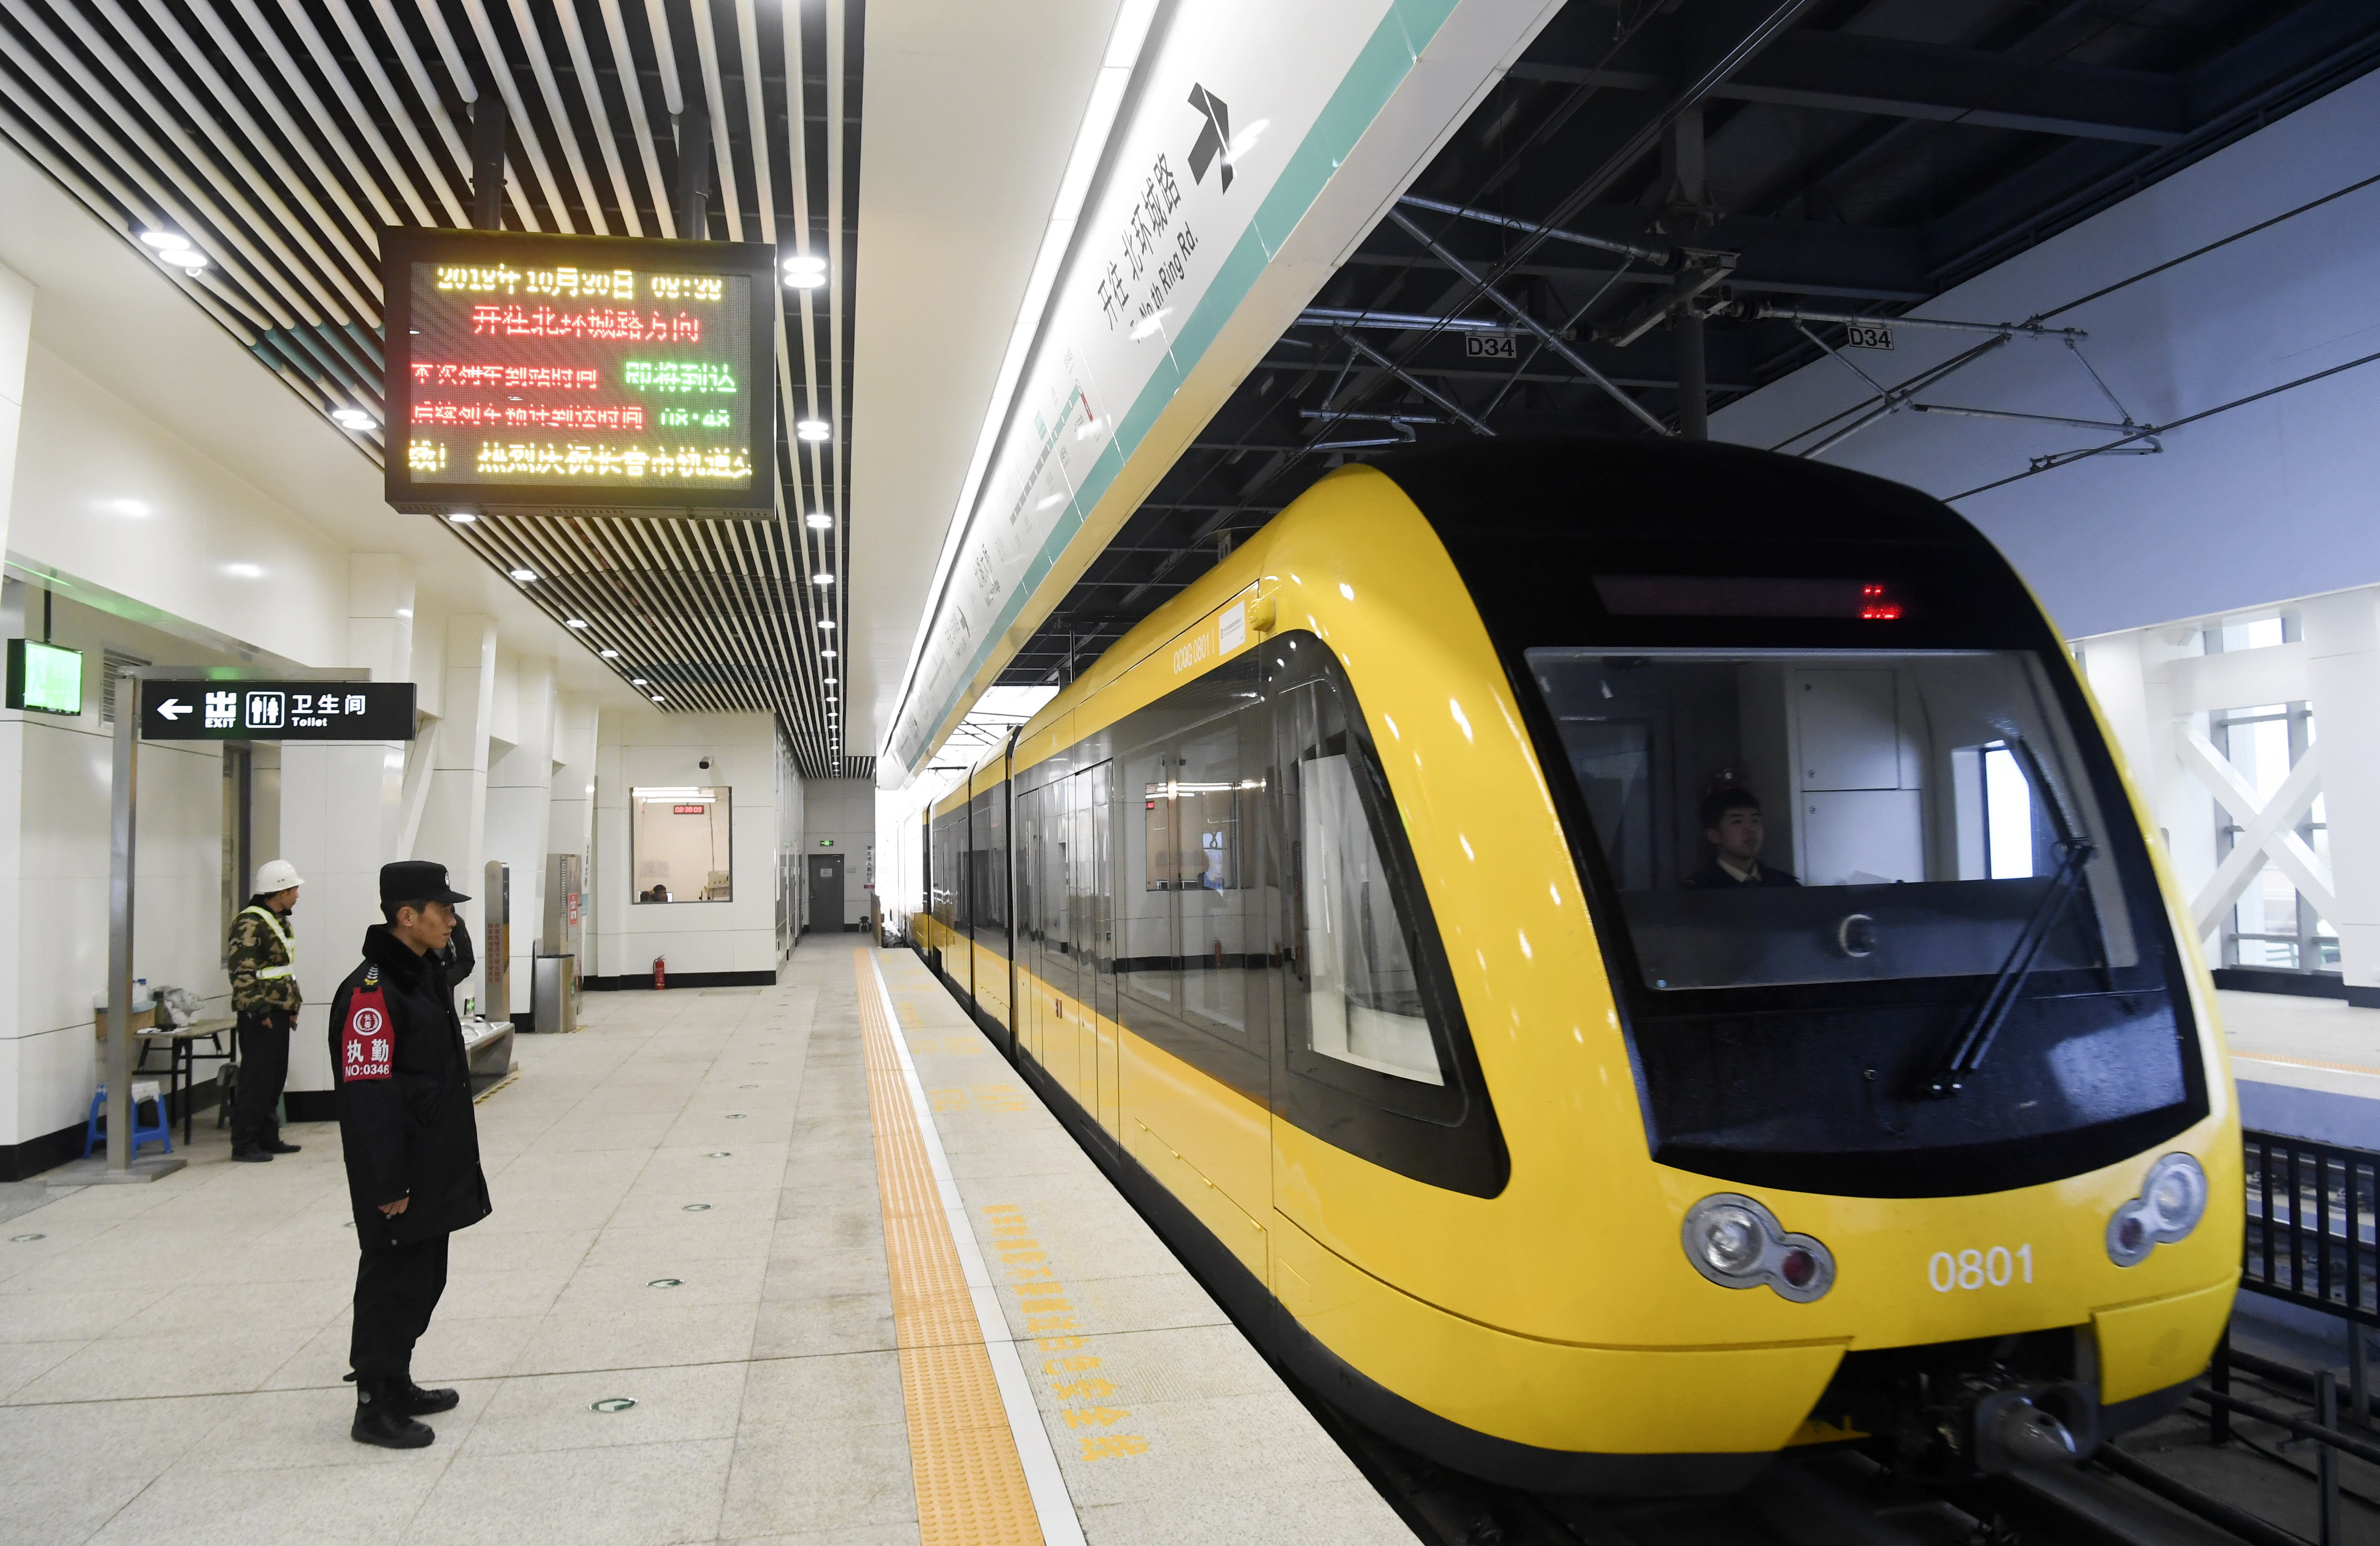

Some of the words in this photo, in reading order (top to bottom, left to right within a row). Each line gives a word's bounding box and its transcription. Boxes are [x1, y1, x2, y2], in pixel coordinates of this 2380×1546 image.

[1097, 260, 1129, 331] 开往
[1122, 152, 1181, 281] 北环城路
[1139, 282, 1164, 320] Noth
[1158, 252, 1185, 295] Ring
[1177, 220, 1198, 262] Rd.
[473, 304, 699, 342] 开往北环城路方向
[1468, 337, 1514, 357] D34
[1849, 328, 1891, 348] D34
[626, 361, 737, 393] 即将到达
[291, 693, 366, 715] 卫生间
[205, 718, 236, 728] EXIT
[291, 716, 328, 727] Toilet
[347, 1038, 389, 1063] 执勤
[345, 1064, 389, 1078] NO:0346
[1928, 1243, 2033, 1292] 0801
